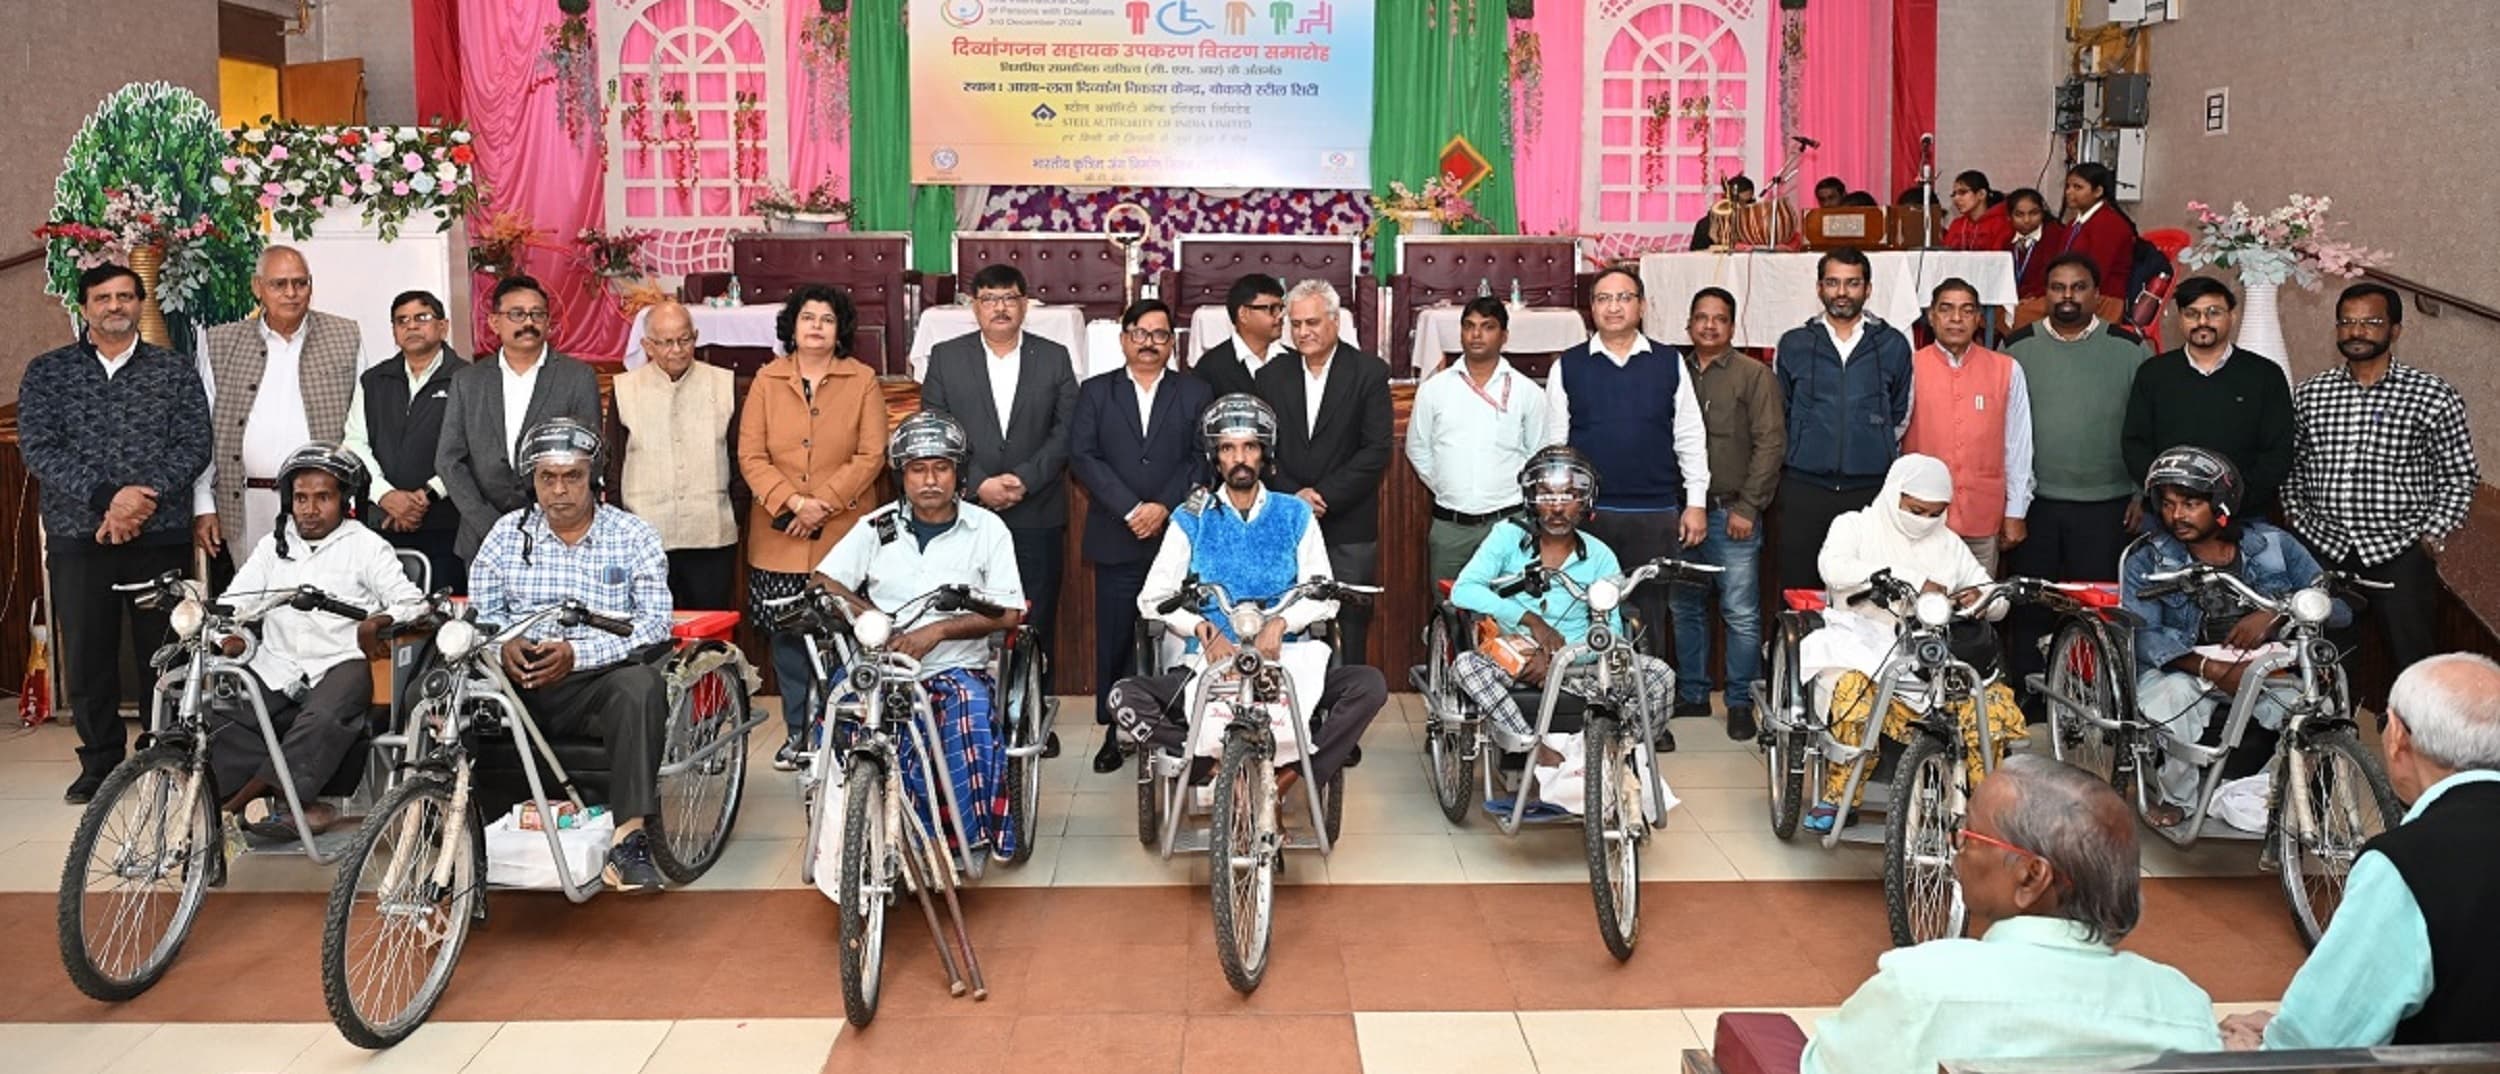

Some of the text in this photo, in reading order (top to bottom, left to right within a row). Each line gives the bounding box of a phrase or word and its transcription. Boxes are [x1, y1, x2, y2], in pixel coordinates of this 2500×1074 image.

[1000, 7, 1039, 15] Persons
[1007, 18, 1055, 26] December
[952, 36, 1330, 61] दिव्यांगजन सहायक उपकरण वितरण समारोह
[1256, 82, 1287, 96] स्टील
[1290, 82, 1319, 96] सिटी
